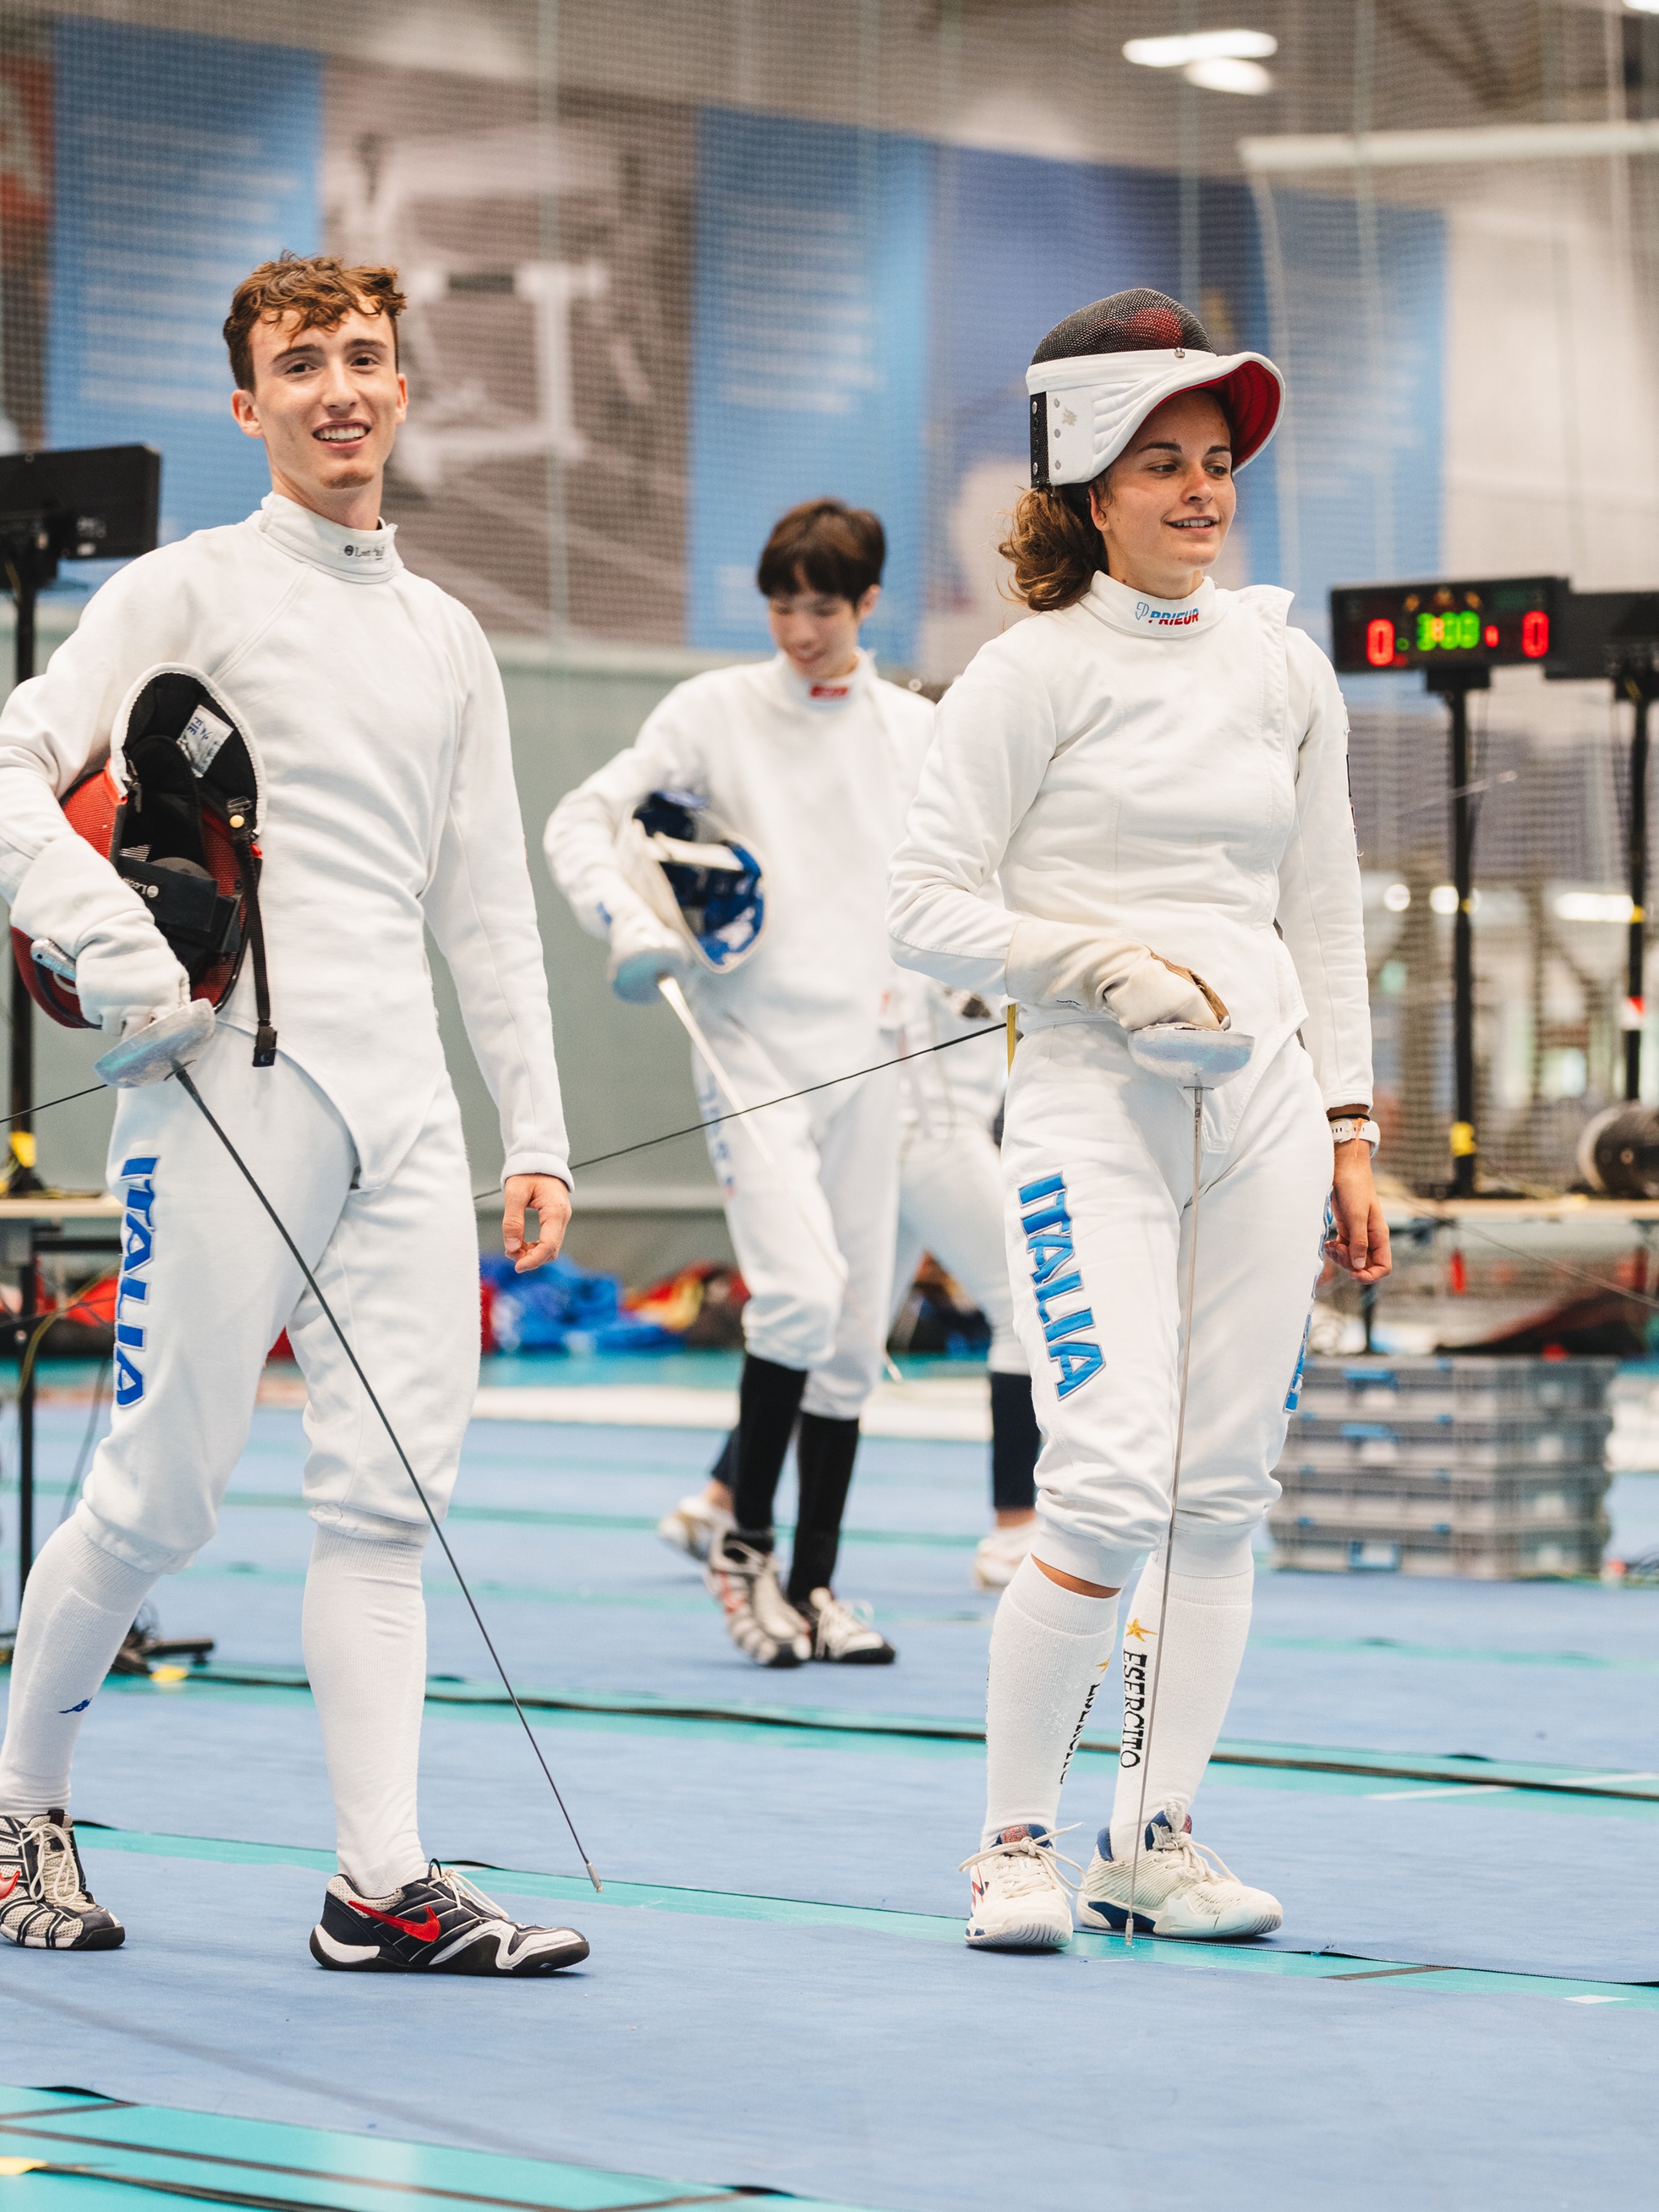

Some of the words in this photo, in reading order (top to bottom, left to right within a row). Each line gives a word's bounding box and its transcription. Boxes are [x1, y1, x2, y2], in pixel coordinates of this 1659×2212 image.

[1148, 608, 1199, 625] PRIEUR
[1366, 618, 1395, 667] 0
[1522, 611, 1549, 658] 0
[187, 717, 204, 736] FIE
[115, 1156, 159, 1408] ITALIA
[1018, 1171, 1106, 1401] ITALIA
[1121, 1648, 1148, 1769] ESERCITO
